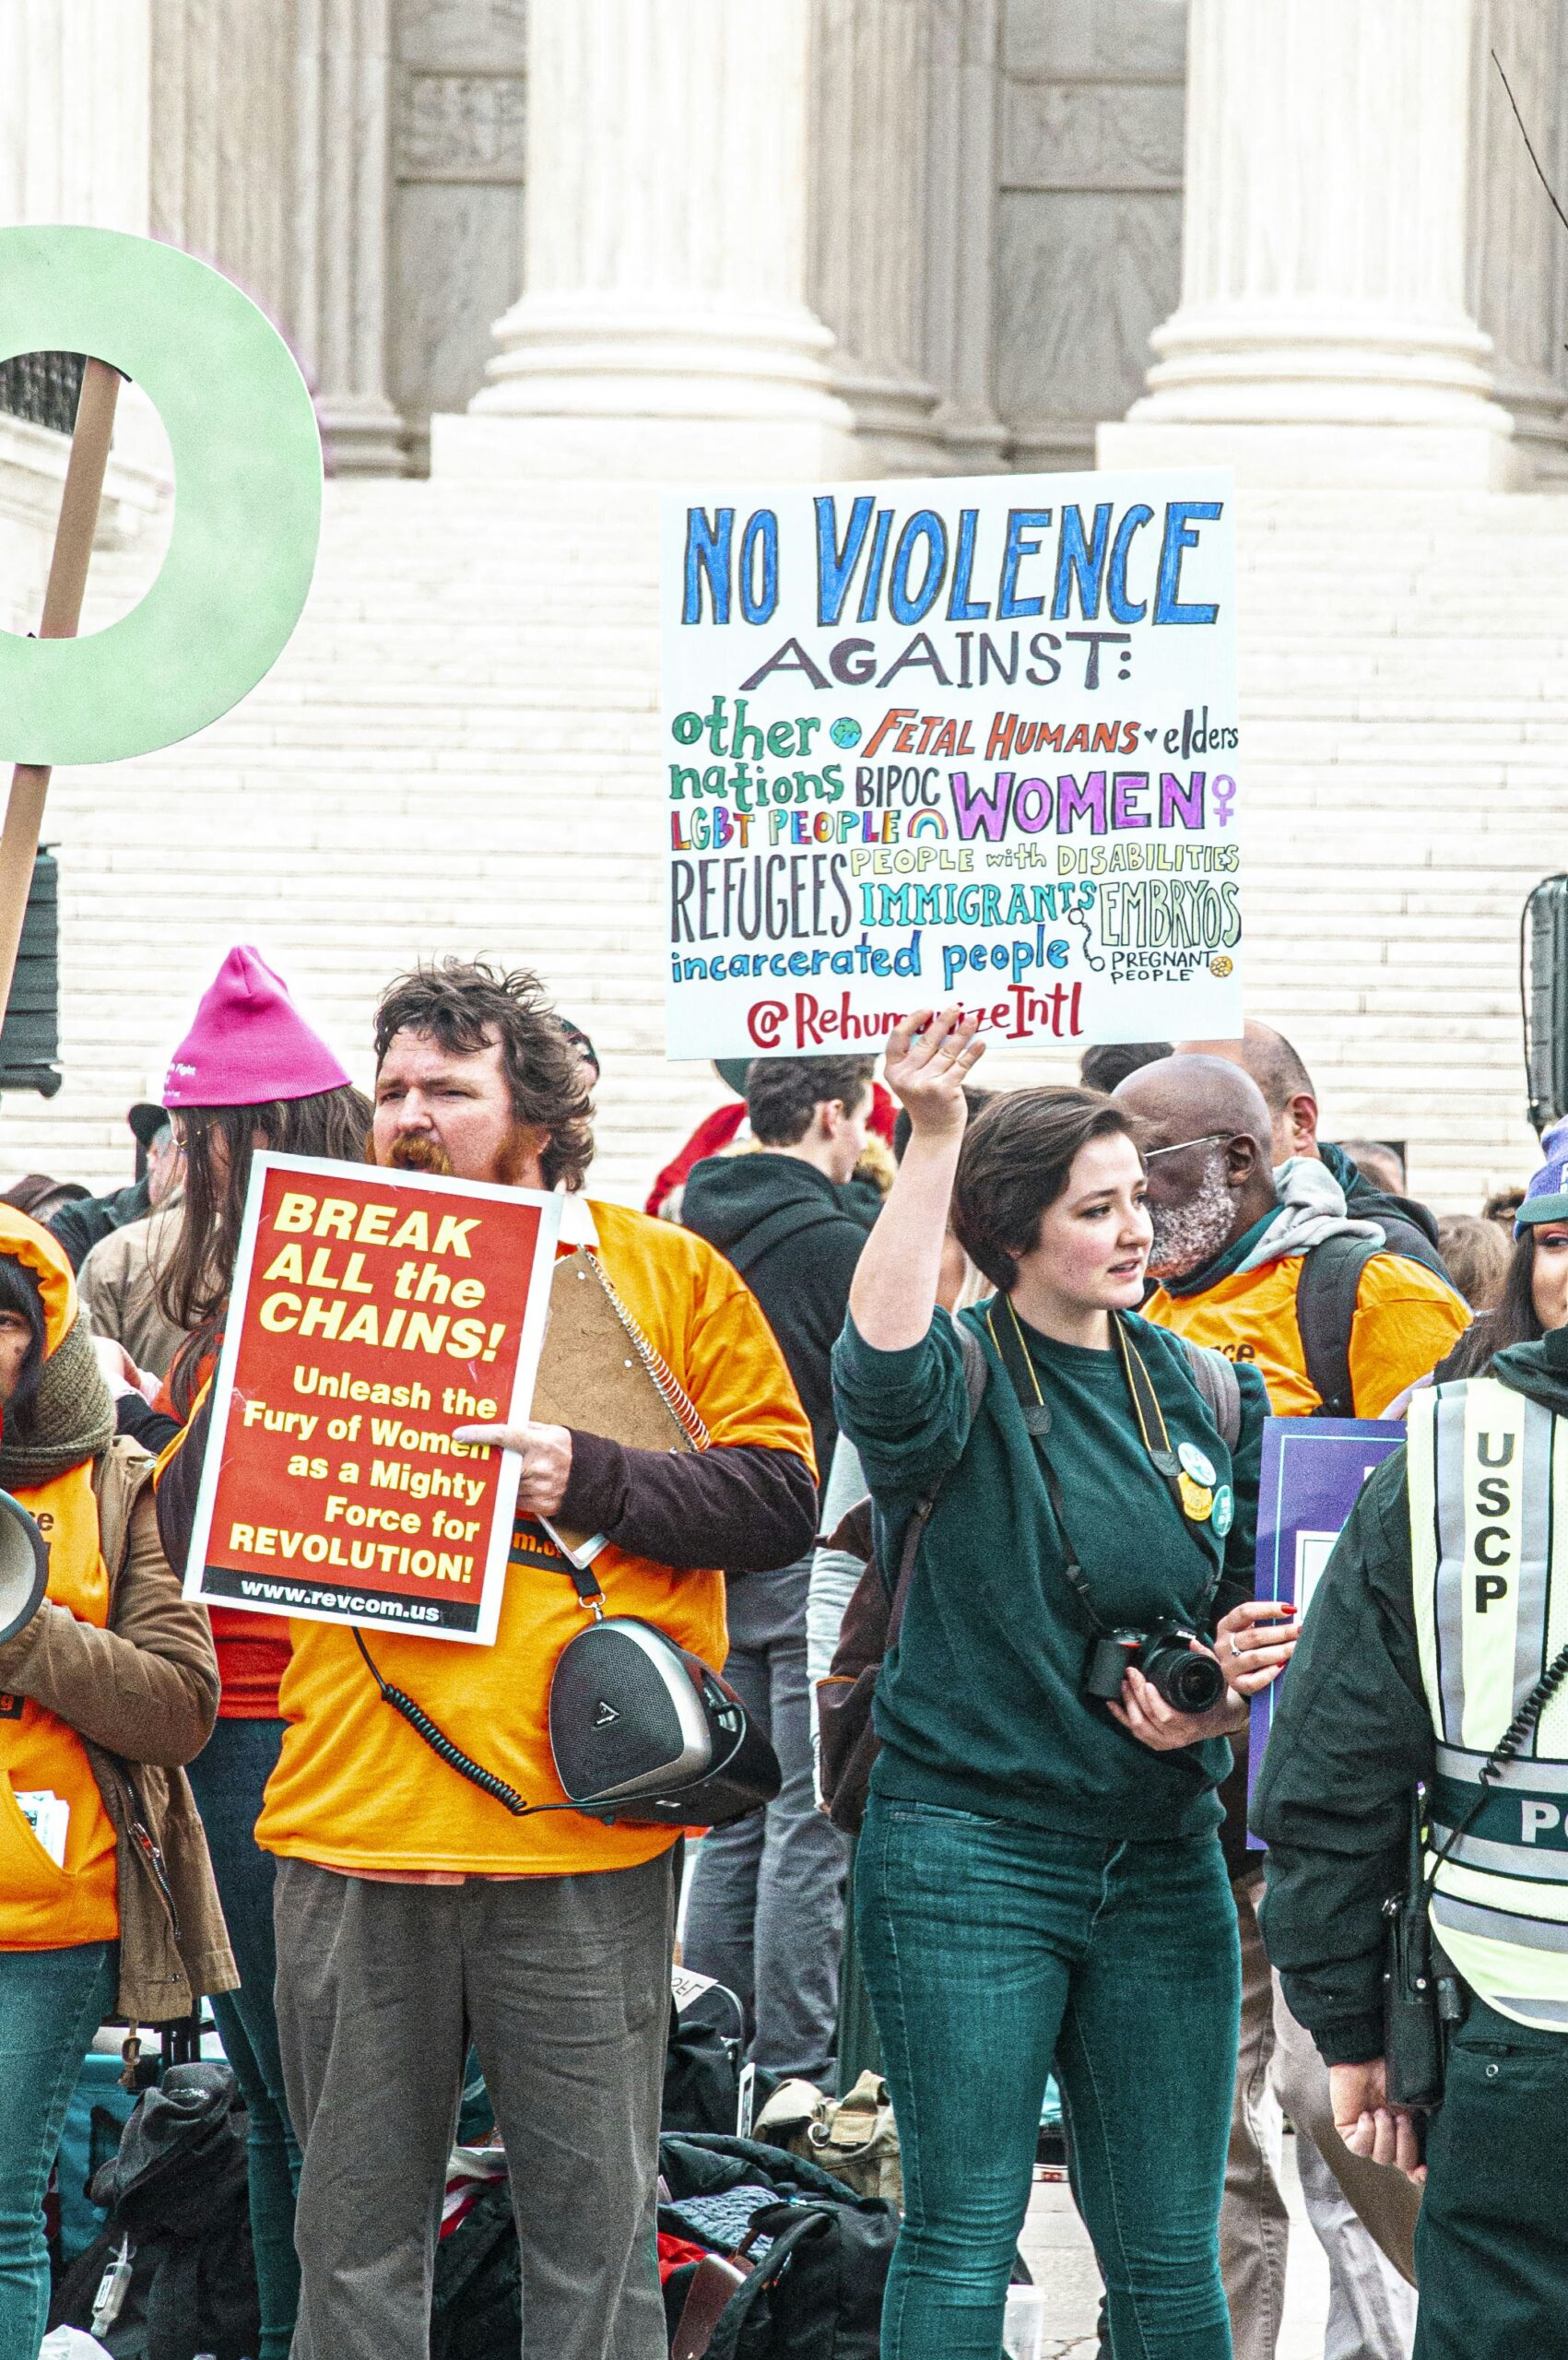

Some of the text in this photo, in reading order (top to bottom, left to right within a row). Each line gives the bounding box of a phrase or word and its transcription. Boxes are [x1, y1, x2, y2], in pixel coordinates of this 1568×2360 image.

[681, 496, 1224, 627] NO VIOLENCE
[739, 631, 1132, 690] AGAINST:
[672, 696, 1239, 761] other FETAL HUMANS elders
[668, 761, 1206, 842] nations BIPOC WOMEN
[671, 806, 899, 850] LGBT PEOPLE
[671, 843, 1240, 943] REFUGEES PEOPLE with DISABILITIES
[859, 879, 1242, 949] IMMIGRANTS EMBRYOS
[671, 924, 1069, 991] incarcerated people
[1111, 950, 1218, 970] PREGNANT
[1111, 970, 1194, 984] PEOPLE
[274, 1192, 482, 1258] BREAK
[264, 1243, 485, 1310] ALL the
[259, 1292, 506, 1363] CHAINS!
[243, 1400, 316, 1443] Fury
[327, 1414, 360, 1442] of
[293, 1366, 497, 1419] Unleash the
[288, 1452, 486, 1506] as a Mighty
[325, 1495, 480, 1542] Force for
[1475, 1432, 1515, 1613] USCP
[230, 1523, 473, 1584] REVOLUTION!
[242, 1580, 440, 1622] www.revcom.us
[1521, 1800, 1568, 1844] P
